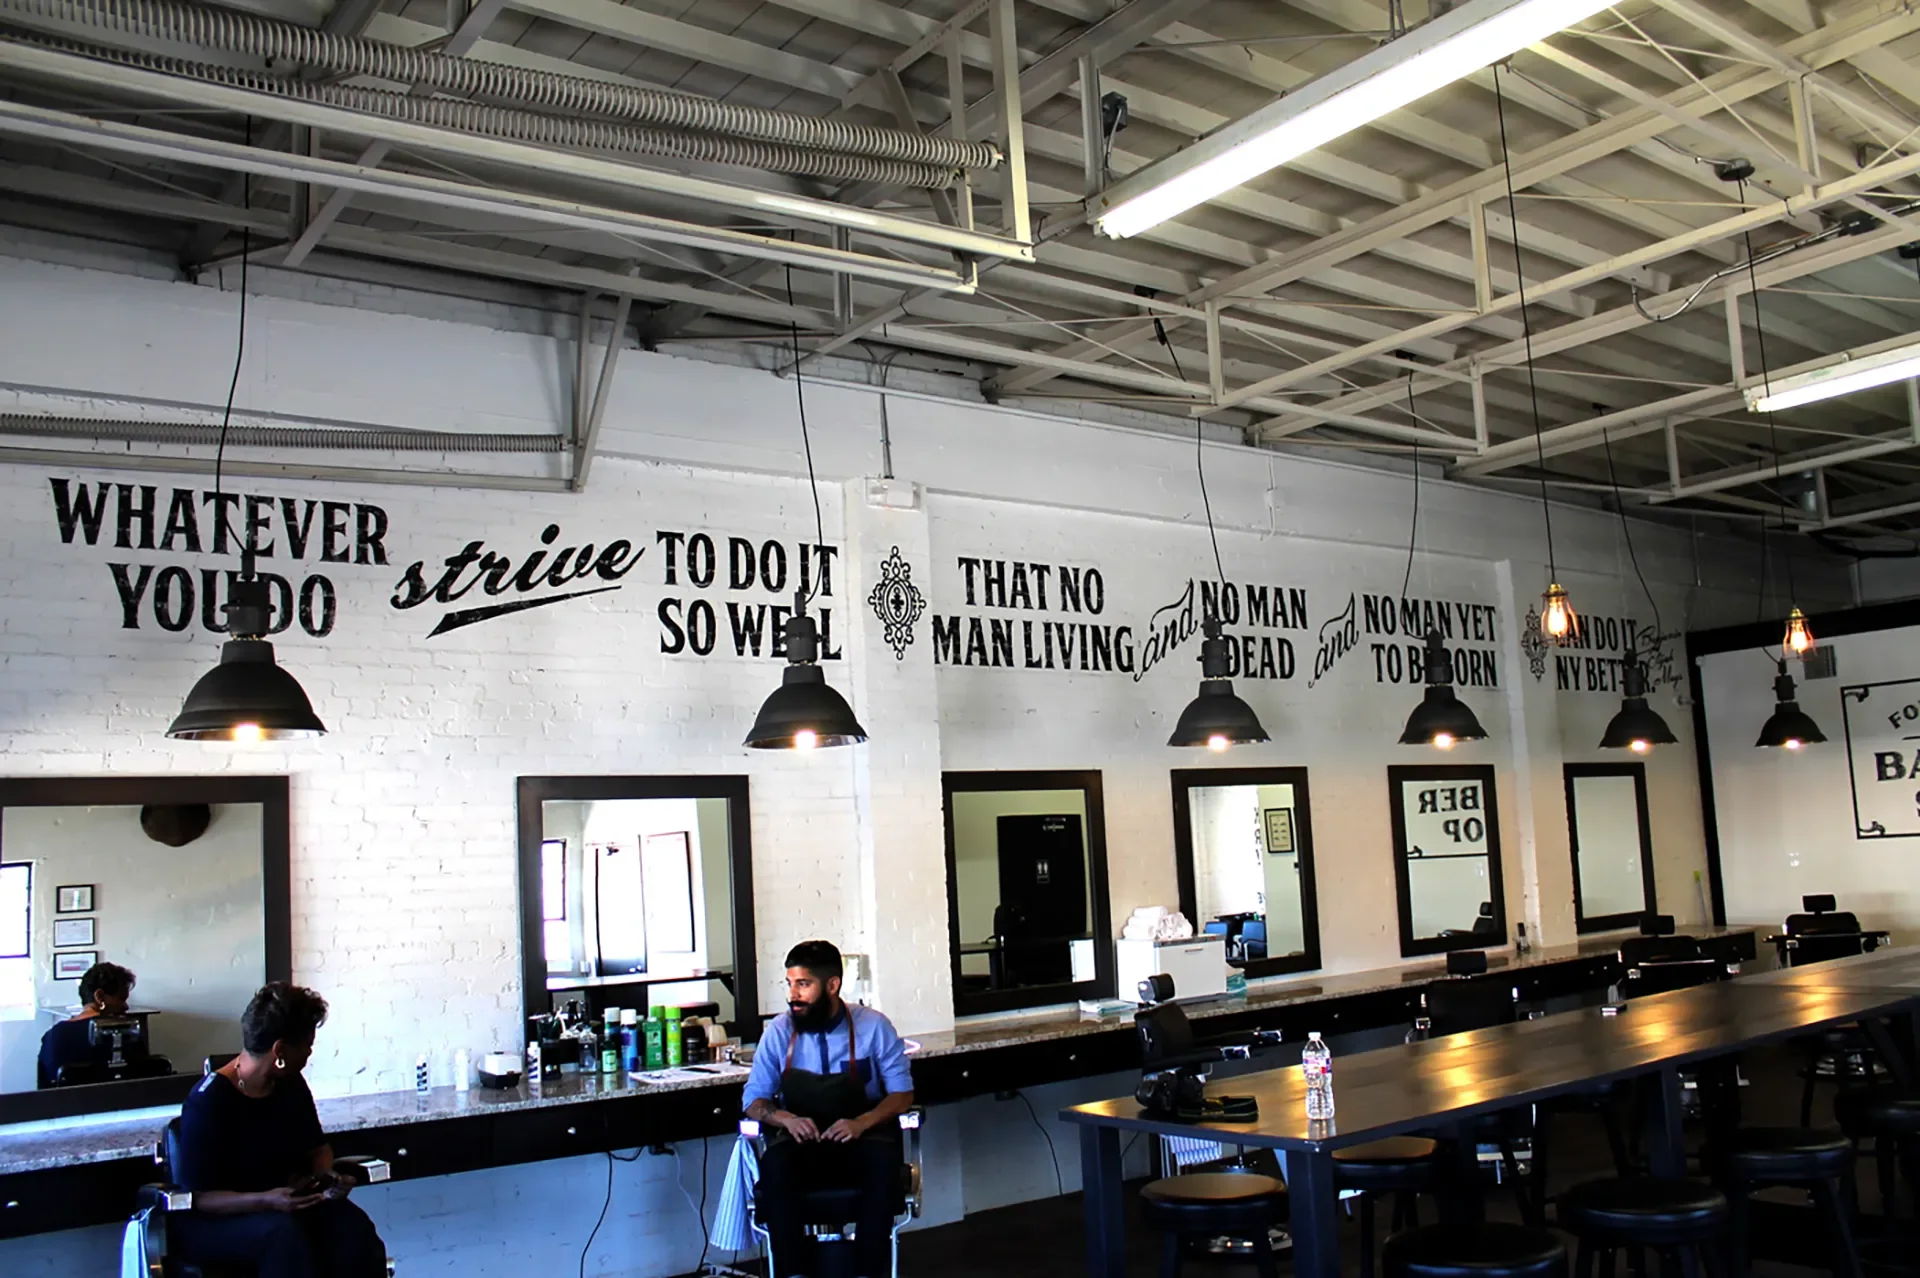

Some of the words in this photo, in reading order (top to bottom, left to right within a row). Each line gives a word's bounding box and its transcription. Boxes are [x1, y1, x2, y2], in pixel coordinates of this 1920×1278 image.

[48, 477, 390, 566] WHATEVER
[390, 523, 645, 609] strive
[656, 530, 717, 589] TO
[729, 536, 788, 594] DO
[798, 543, 838, 597] IT
[957, 556, 1051, 611] THAT
[1059, 566, 1104, 616] NO
[106, 562, 242, 633] YOU
[253, 572, 337, 639] DO
[657, 599, 717, 657] SO
[726, 602, 842, 661] WEL
[1133, 577, 1199, 682] and
[1200, 580, 1240, 626] NO
[1246, 584, 1308, 630] MAN
[1362, 594, 1397, 636] NO
[1401, 598, 1452, 640] MAN
[1455, 602, 1496, 642] YET
[932, 615, 1016, 668] MAN
[1023, 620, 1135, 674] LIVING
[1222, 635, 1296, 680] DEAD
[1308, 592, 1359, 688] and
[1593, 616, 1618, 651] DO
[1621, 618, 1637, 652] IT
[1371, 643, 1402, 684] TO
[1407, 645, 1433, 685] B
[1445, 648, 1498, 687] ORN
[1585, 656, 1657, 693] BETR.
[1888, 700, 1920, 729] FO
